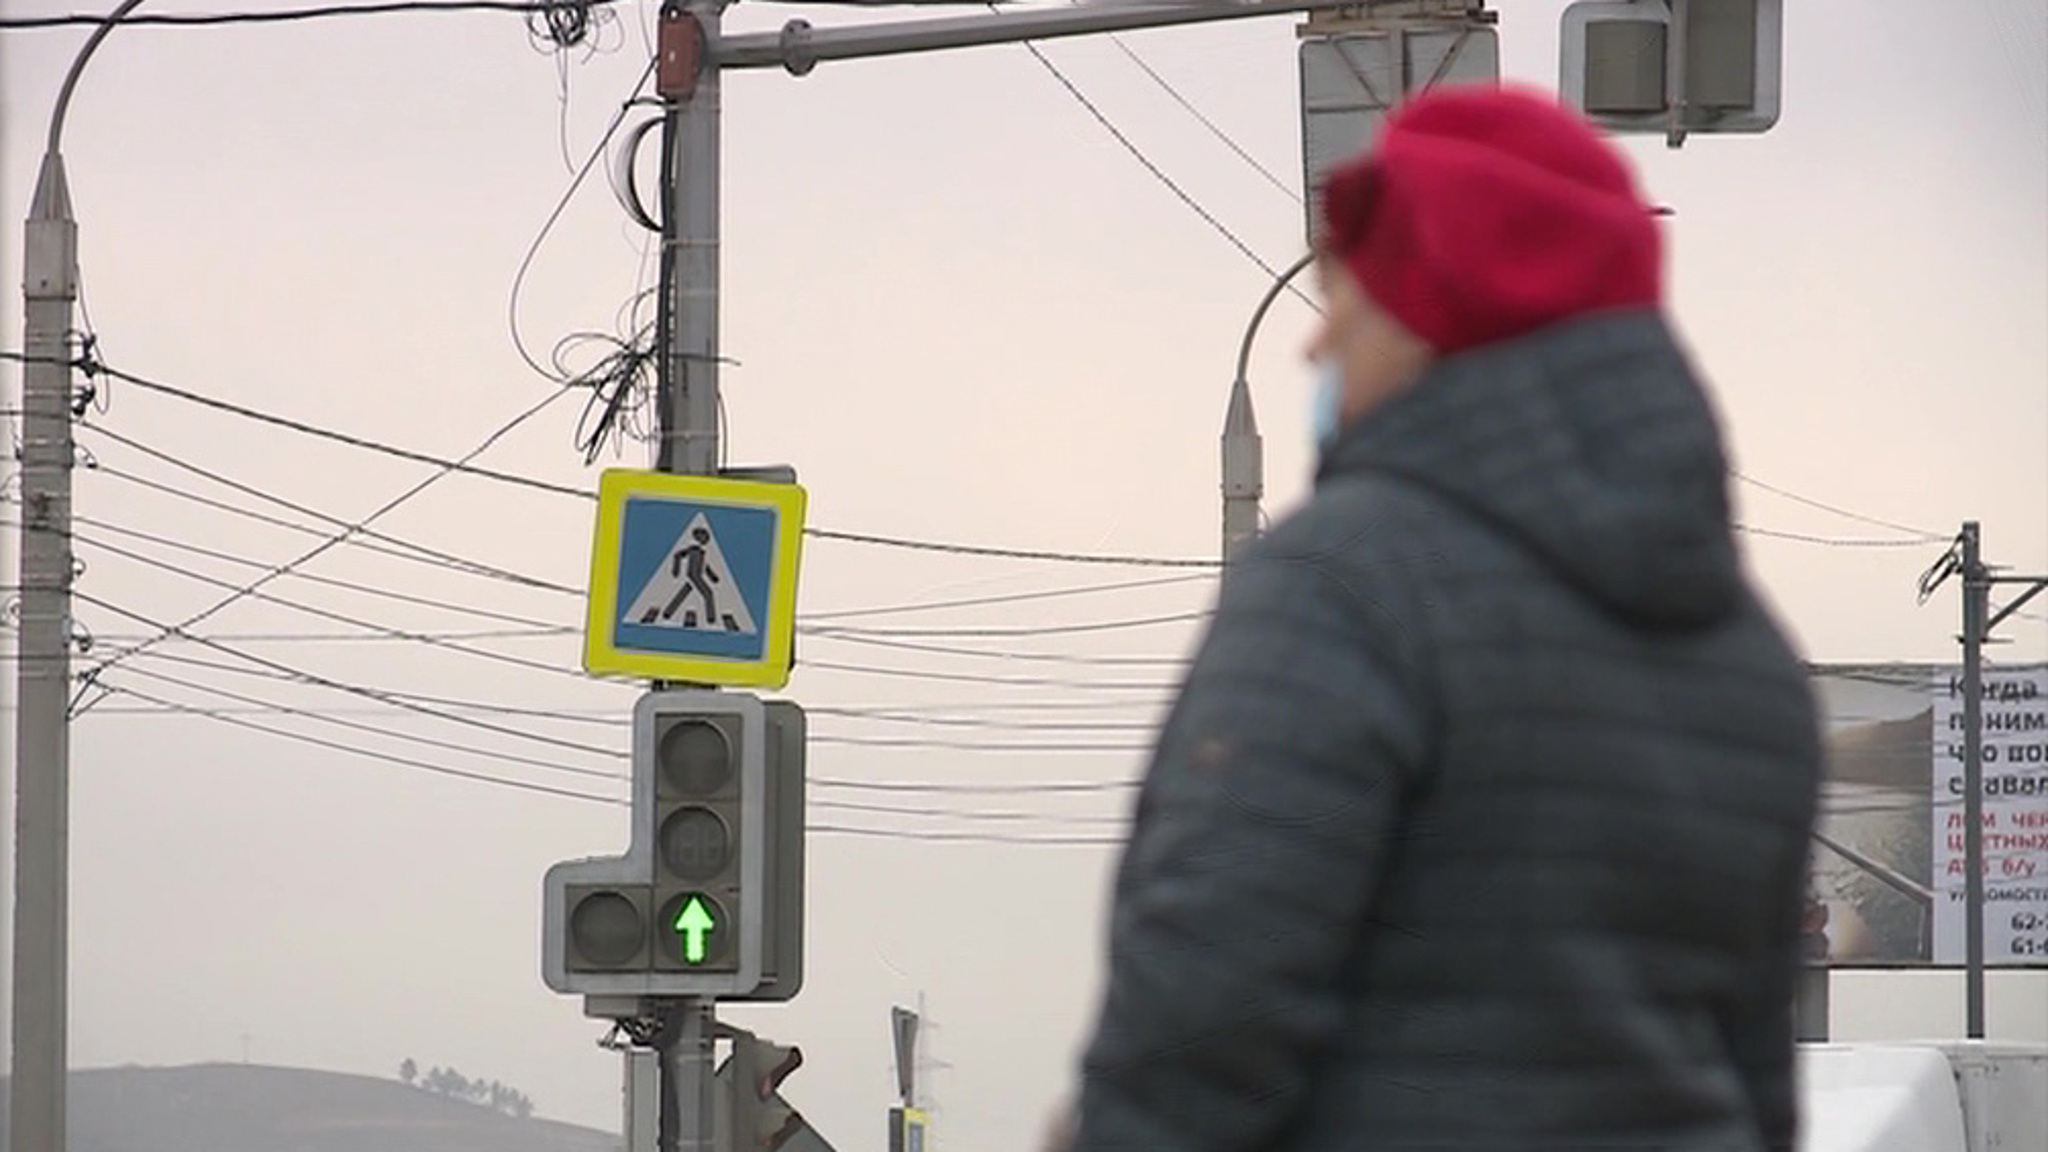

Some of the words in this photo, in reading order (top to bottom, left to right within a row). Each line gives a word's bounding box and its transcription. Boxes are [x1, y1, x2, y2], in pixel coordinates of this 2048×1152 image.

[1949, 676, 2037, 704] Кгда
[1949, 712, 2044, 730] пним
[1948, 744, 1998, 762] чо
[1949, 776, 2048, 795] савал
[1947, 813, 1995, 828] ЛМ
[2011, 912, 2048, 931] 62-
